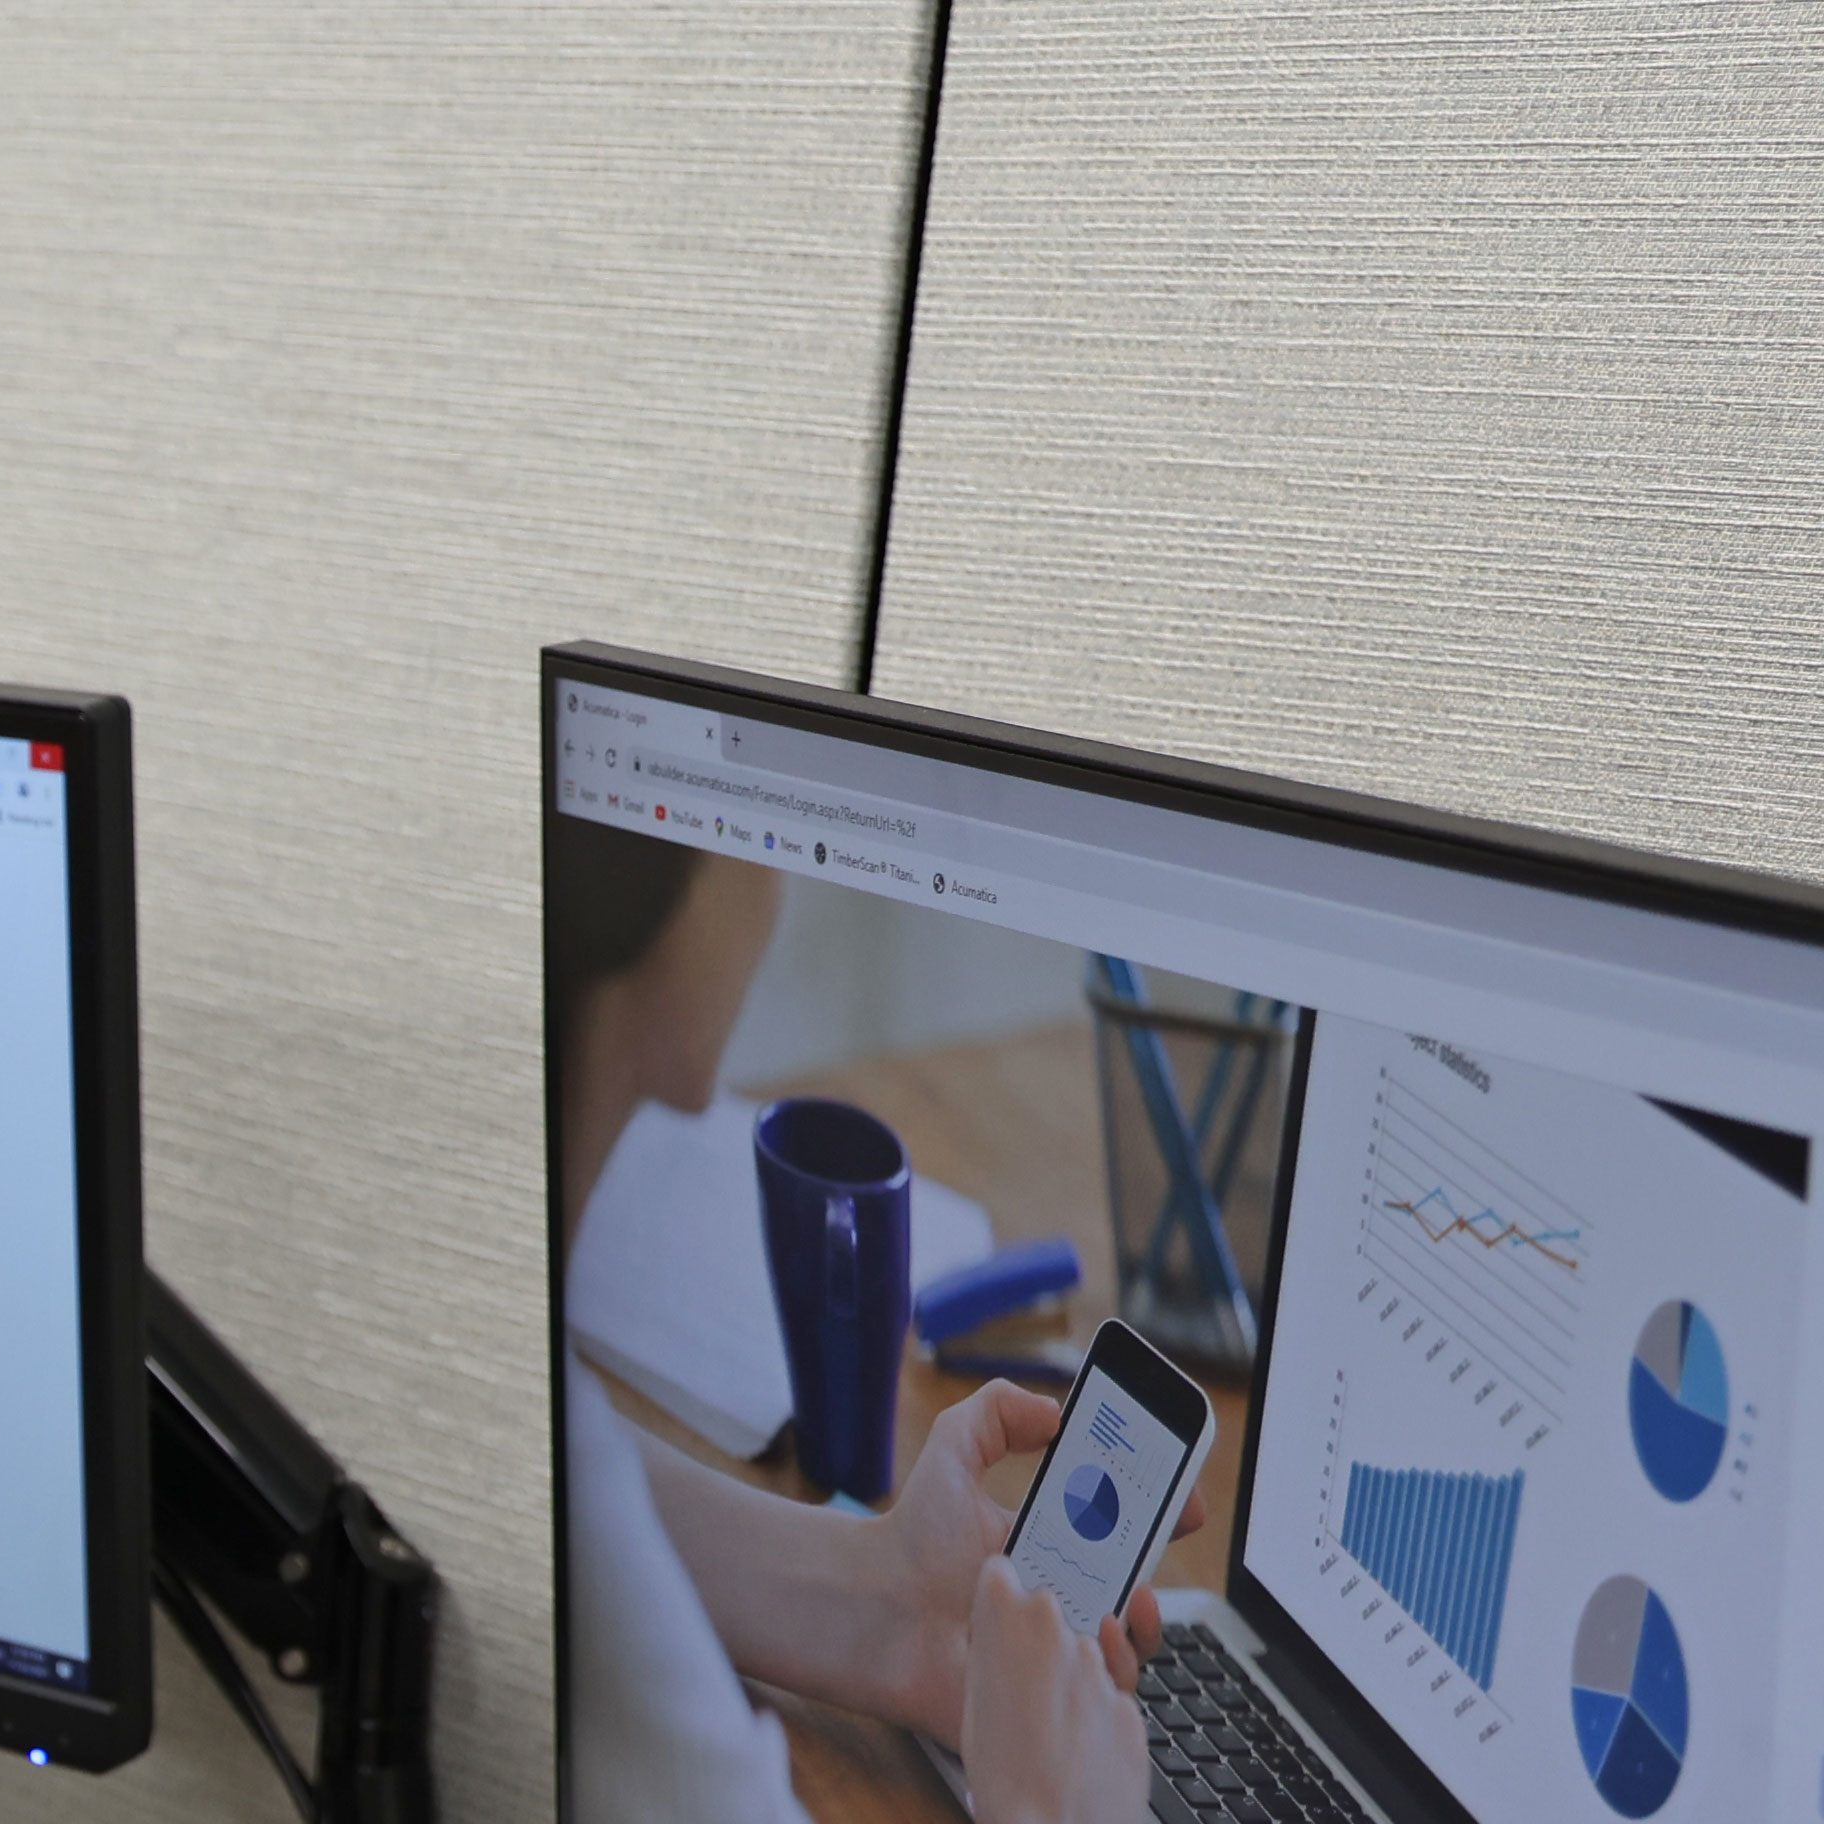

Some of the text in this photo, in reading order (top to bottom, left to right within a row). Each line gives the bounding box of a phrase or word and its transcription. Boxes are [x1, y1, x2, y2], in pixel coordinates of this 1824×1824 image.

[671, 809, 703, 829] YouTube
[730, 824, 752, 843] Maps
[780, 836, 803, 855] News
[951, 879, 998, 904] Acumatica
